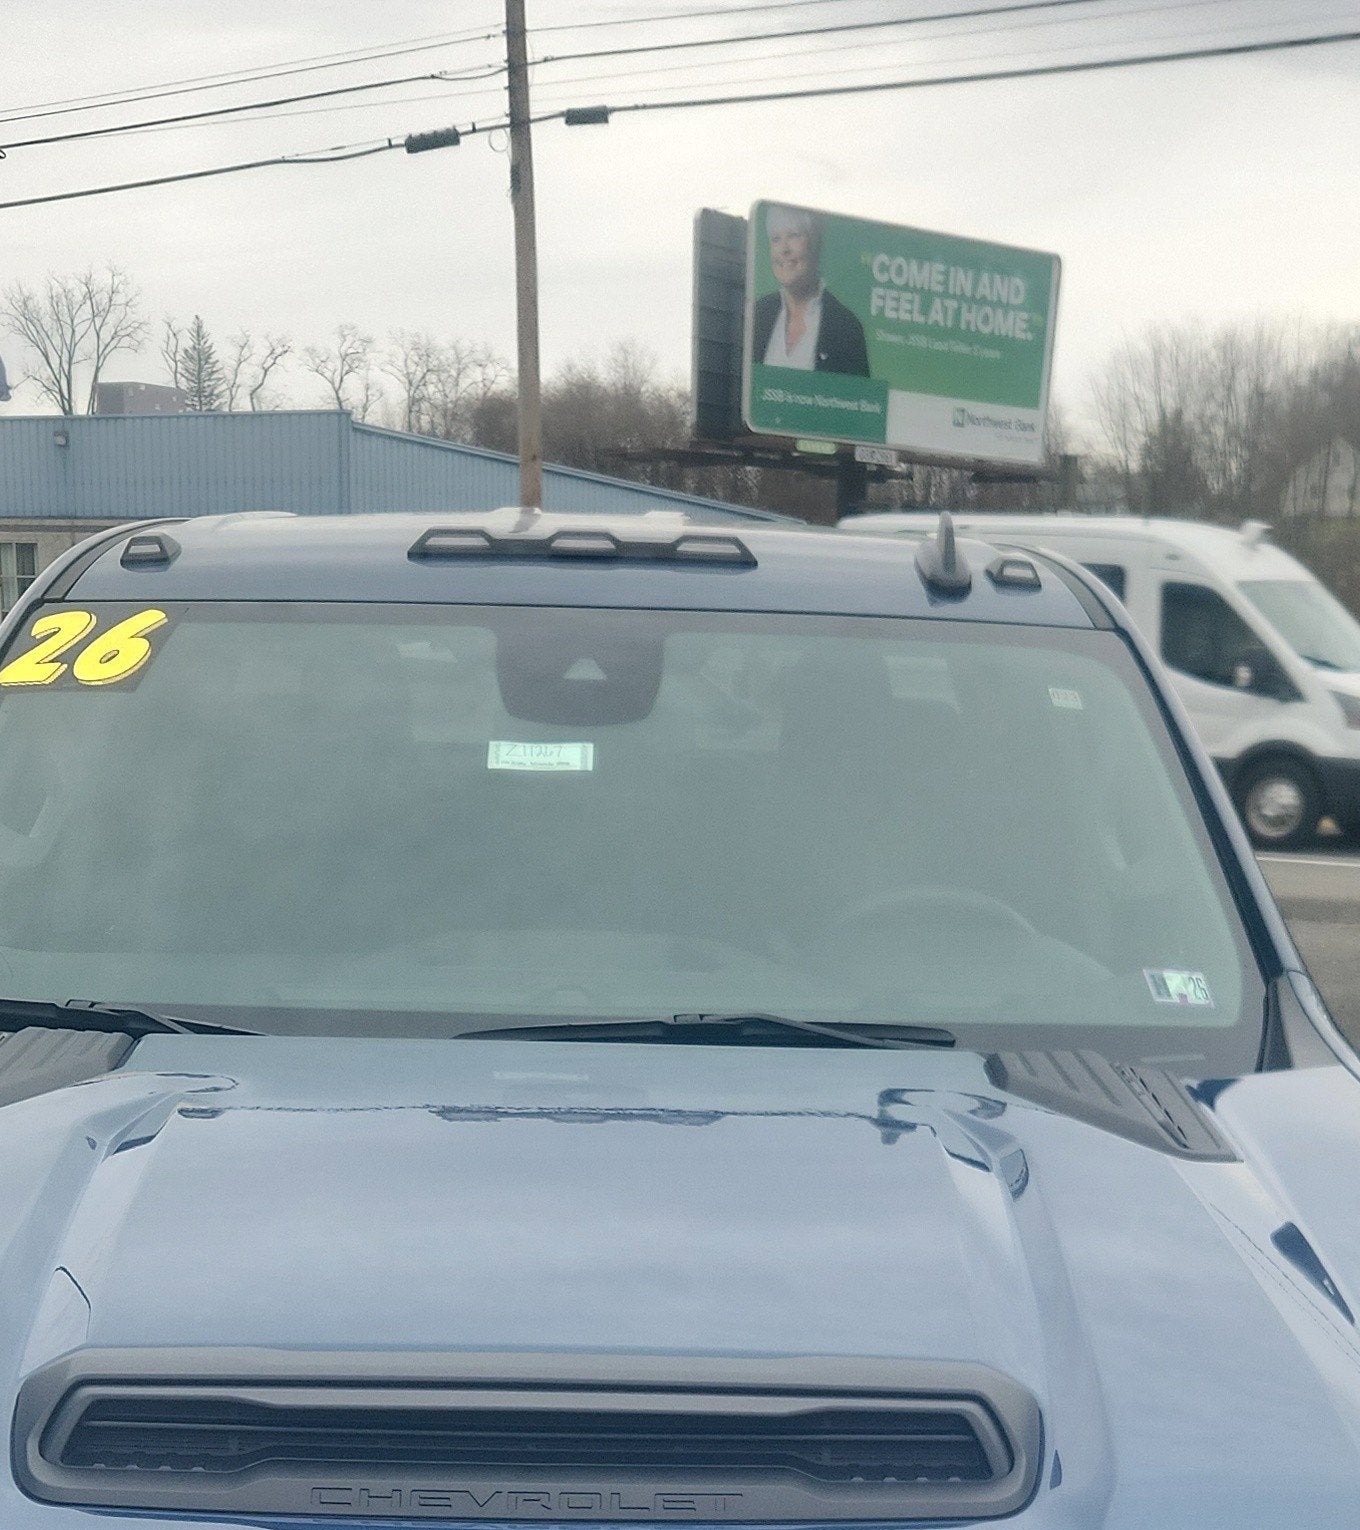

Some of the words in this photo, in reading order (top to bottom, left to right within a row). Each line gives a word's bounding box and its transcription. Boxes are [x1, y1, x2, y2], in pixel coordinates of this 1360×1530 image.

[948, 266, 974, 298] IN
[975, 272, 1026, 305] AND
[870, 286, 926, 324] FEEL
[927, 297, 958, 328] AT
[310, 1487, 744, 1512] CHEVROLET
